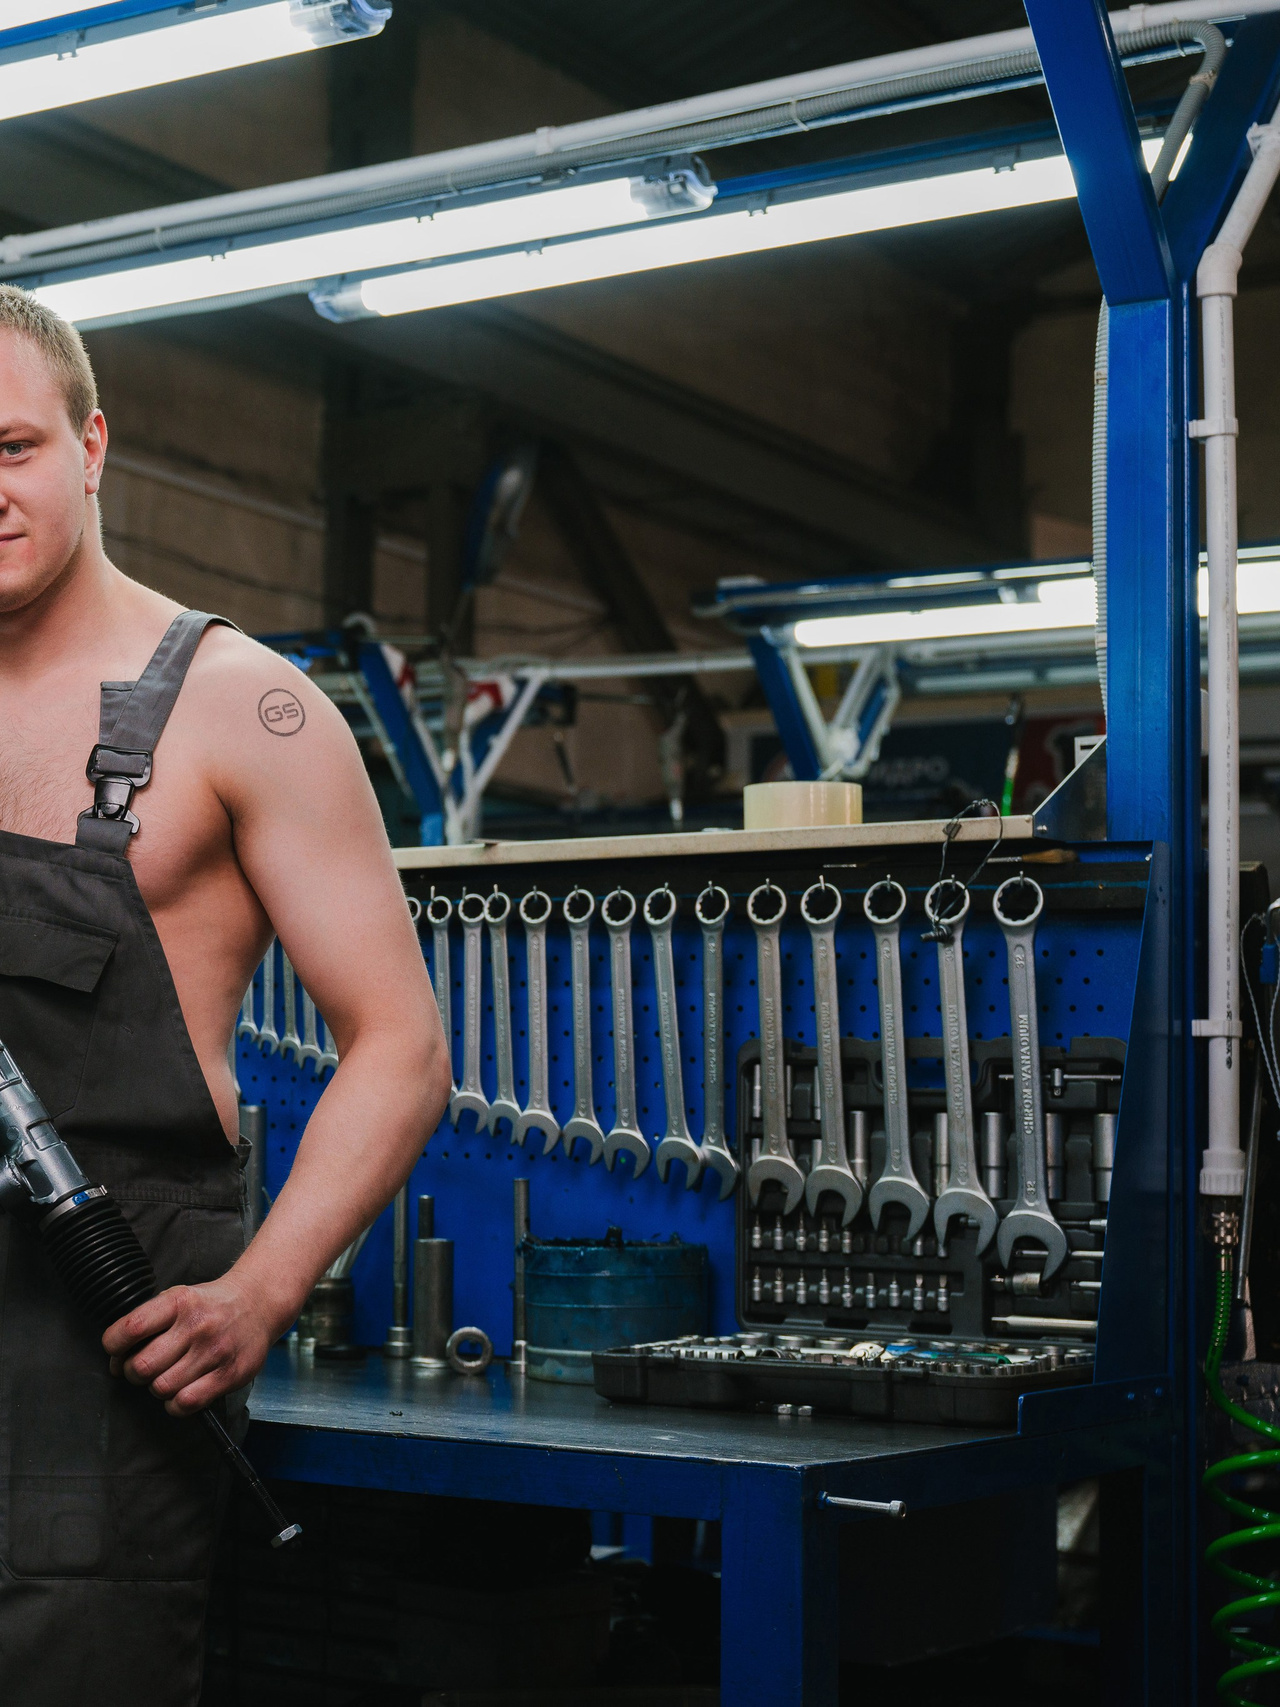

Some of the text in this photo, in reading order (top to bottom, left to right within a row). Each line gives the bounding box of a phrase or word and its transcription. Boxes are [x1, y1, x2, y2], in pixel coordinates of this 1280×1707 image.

[264, 702, 299, 723] GS
[1015, 953, 1025, 970] 32
[1018, 1014, 1034, 1135] CHROM-VANADIUM
[1025, 1180, 1036, 1195] 32
